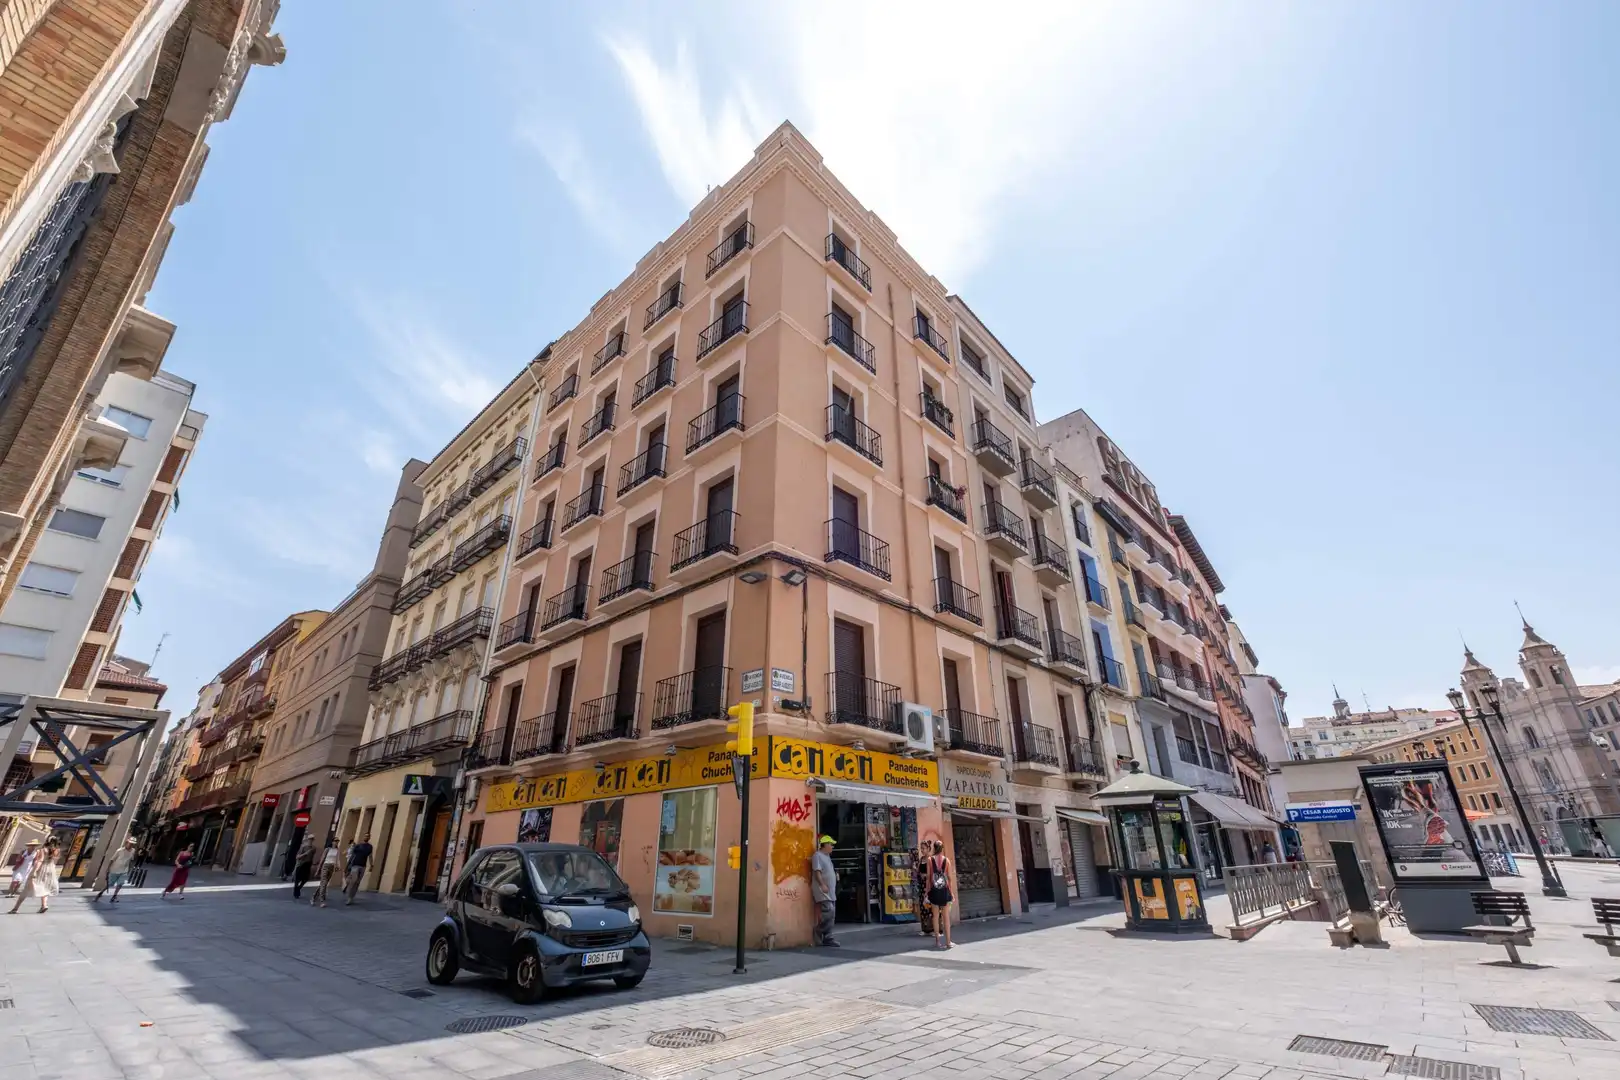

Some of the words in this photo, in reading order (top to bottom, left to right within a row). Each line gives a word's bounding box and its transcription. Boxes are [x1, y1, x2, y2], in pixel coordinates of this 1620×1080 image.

[708, 746, 758, 764] Panaa
[701, 761, 758, 779] Chuchs
[888, 760, 928, 776] Panadería
[945, 777, 1004, 797] ZAPATERO
[959, 796, 997, 809] AFILADOR
[1289, 810, 1299, 821] P
[1385, 820, 1401, 829] 10K
